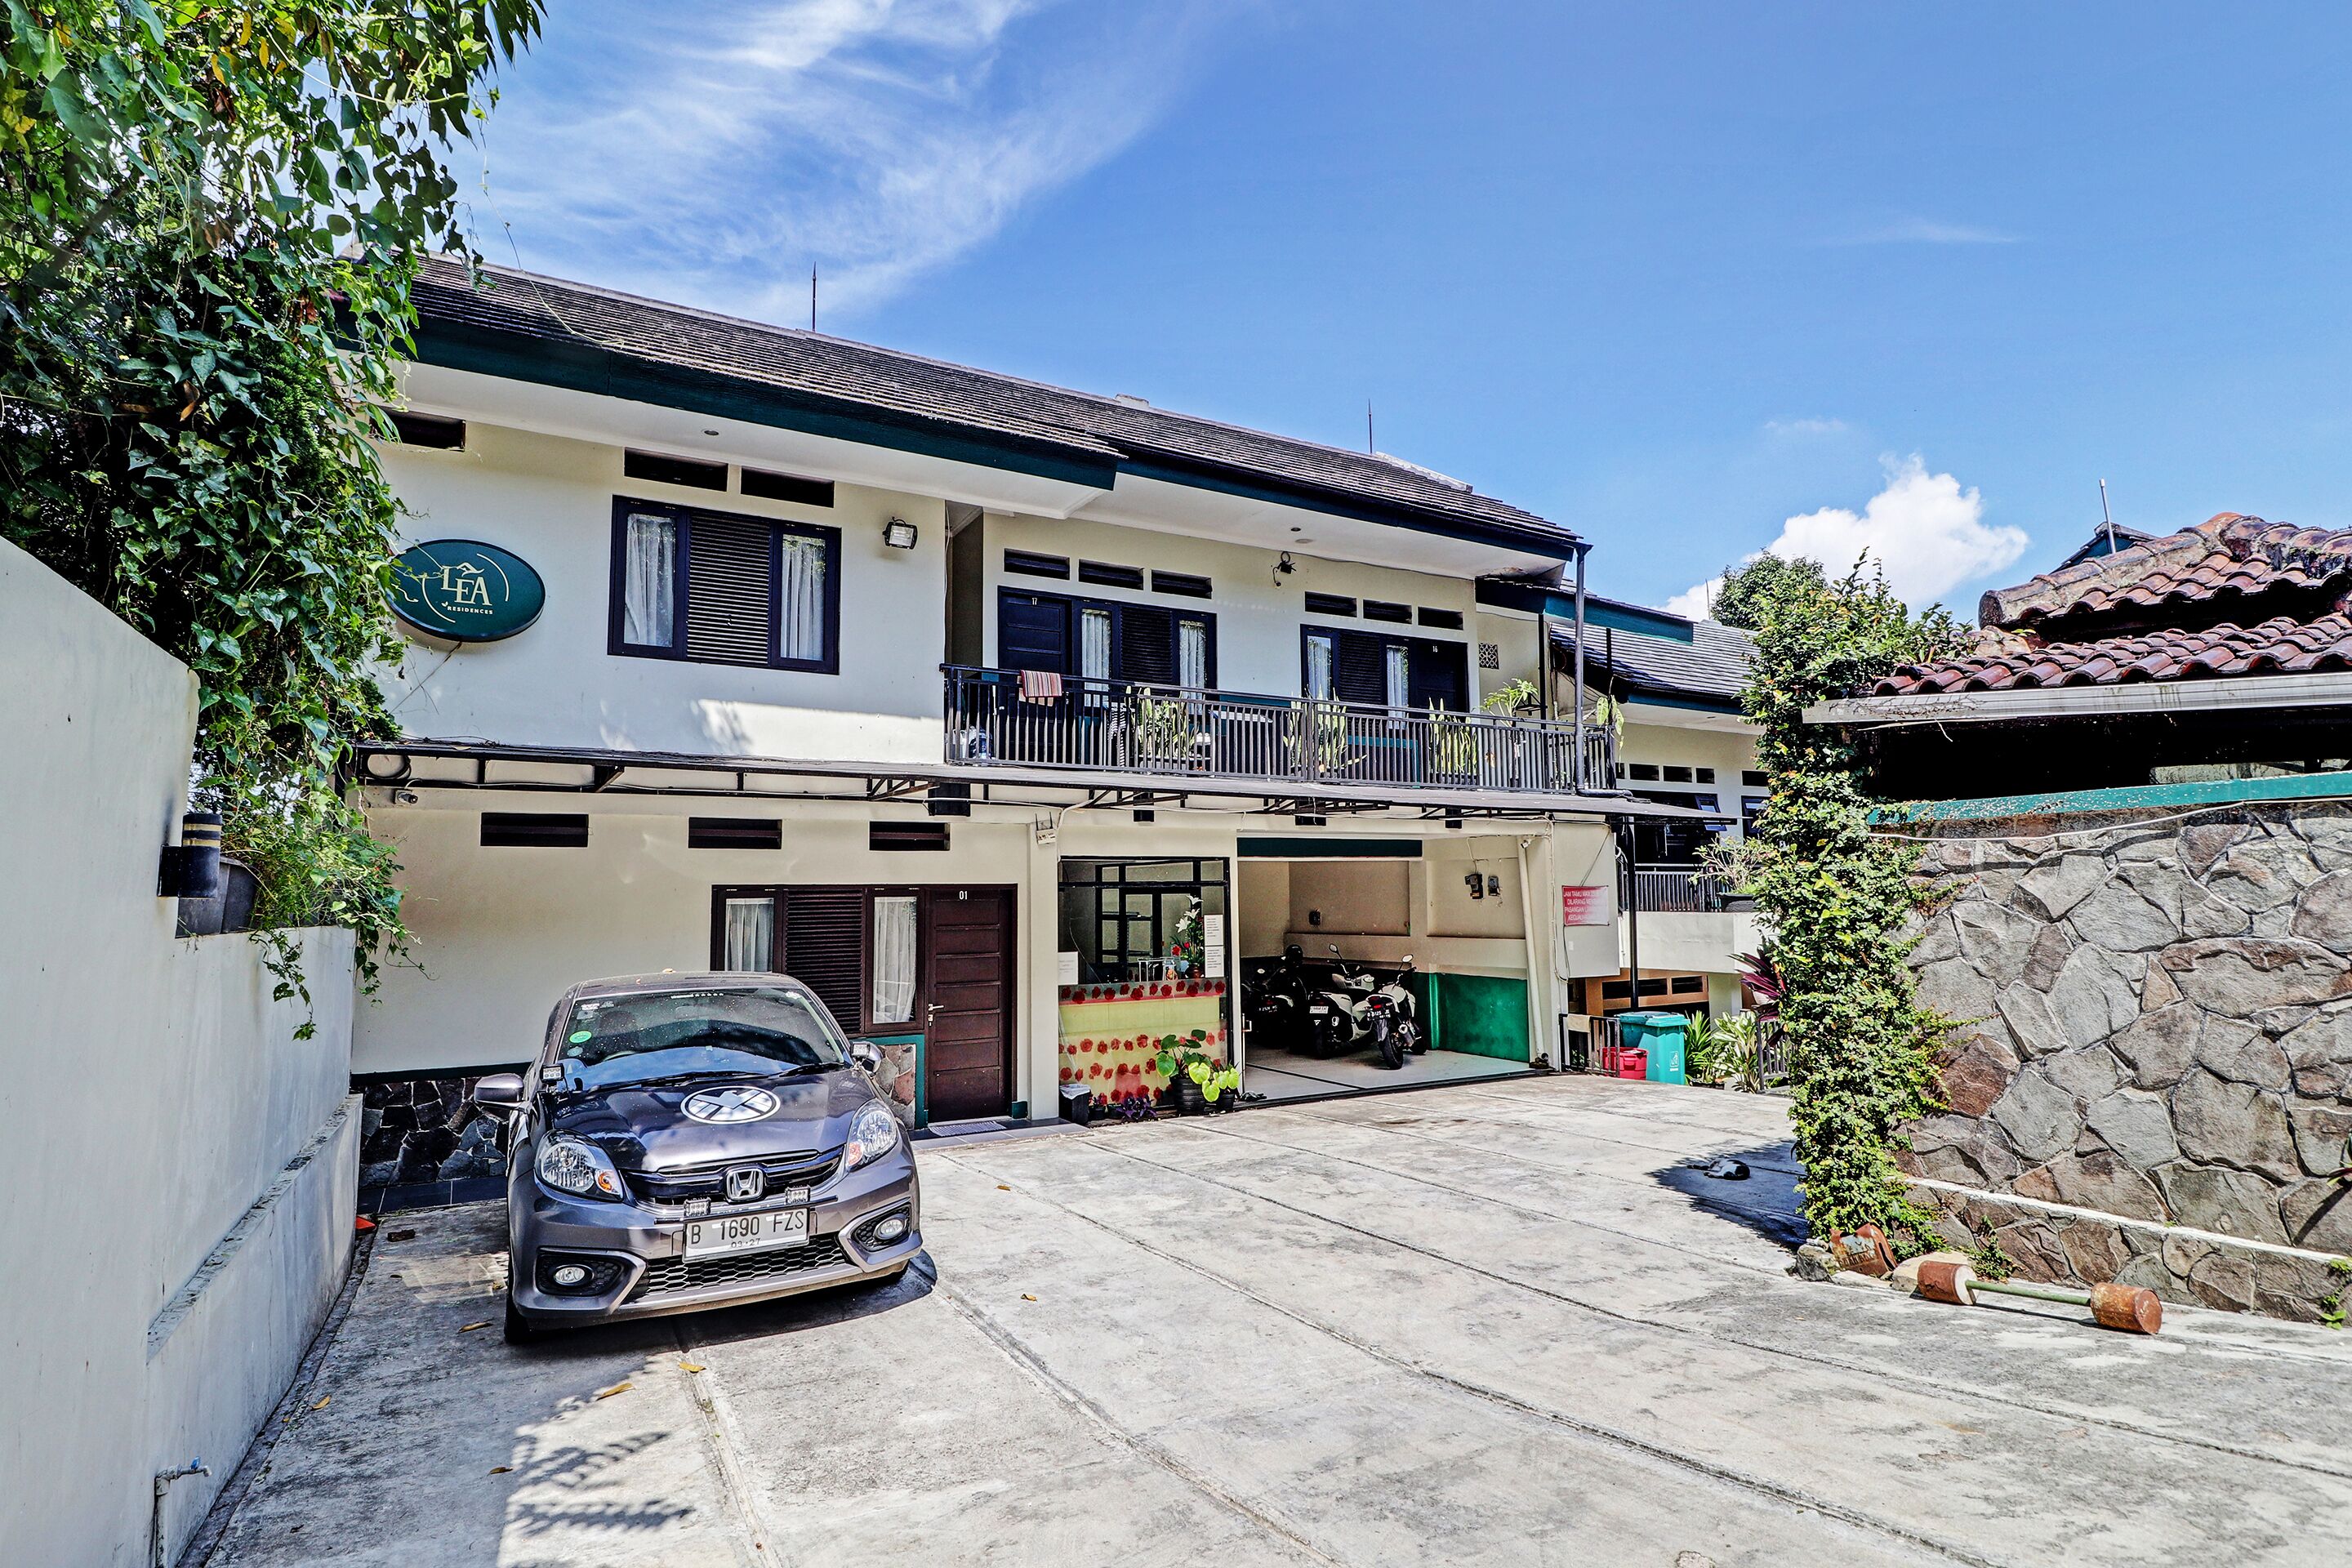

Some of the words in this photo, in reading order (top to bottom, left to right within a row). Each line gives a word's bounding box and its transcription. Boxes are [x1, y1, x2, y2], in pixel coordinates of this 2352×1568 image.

[441, 565, 492, 606] LEA
[1031, 597, 1038, 605] 17
[447, 606, 493, 614] RESIDENCES
[959, 890, 968, 900] 01
[691, 1224, 702, 1245] B
[720, 1216, 760, 1240] 1690
[773, 1210, 804, 1233] FZS
